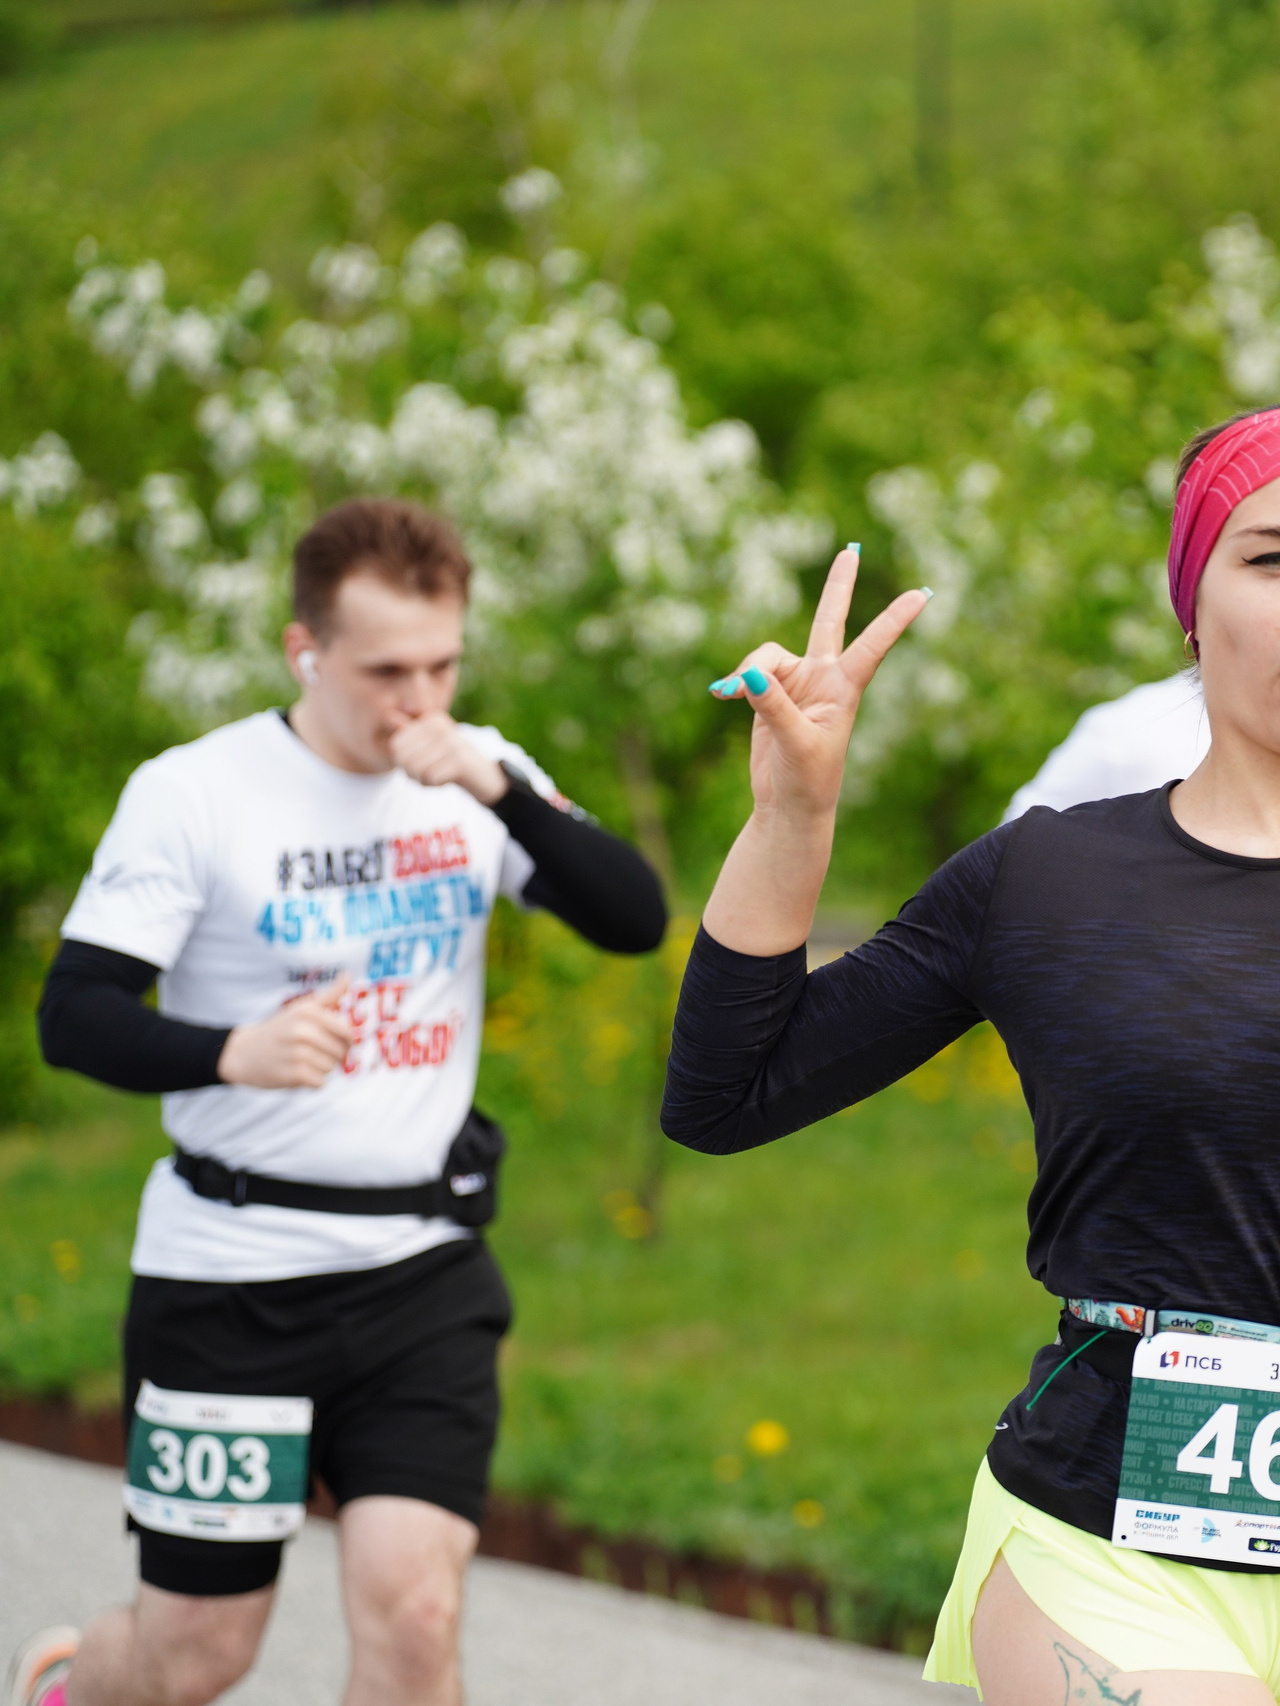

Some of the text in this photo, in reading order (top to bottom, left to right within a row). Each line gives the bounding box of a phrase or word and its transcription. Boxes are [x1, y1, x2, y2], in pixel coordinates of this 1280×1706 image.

[1185, 1355, 1222, 1371] ПСБ
[146, 1428, 271, 1502] 303
[1135, 1509, 1180, 1521] СИБУР
[1134, 1521, 1179, 1533] ФОРМУЛА
